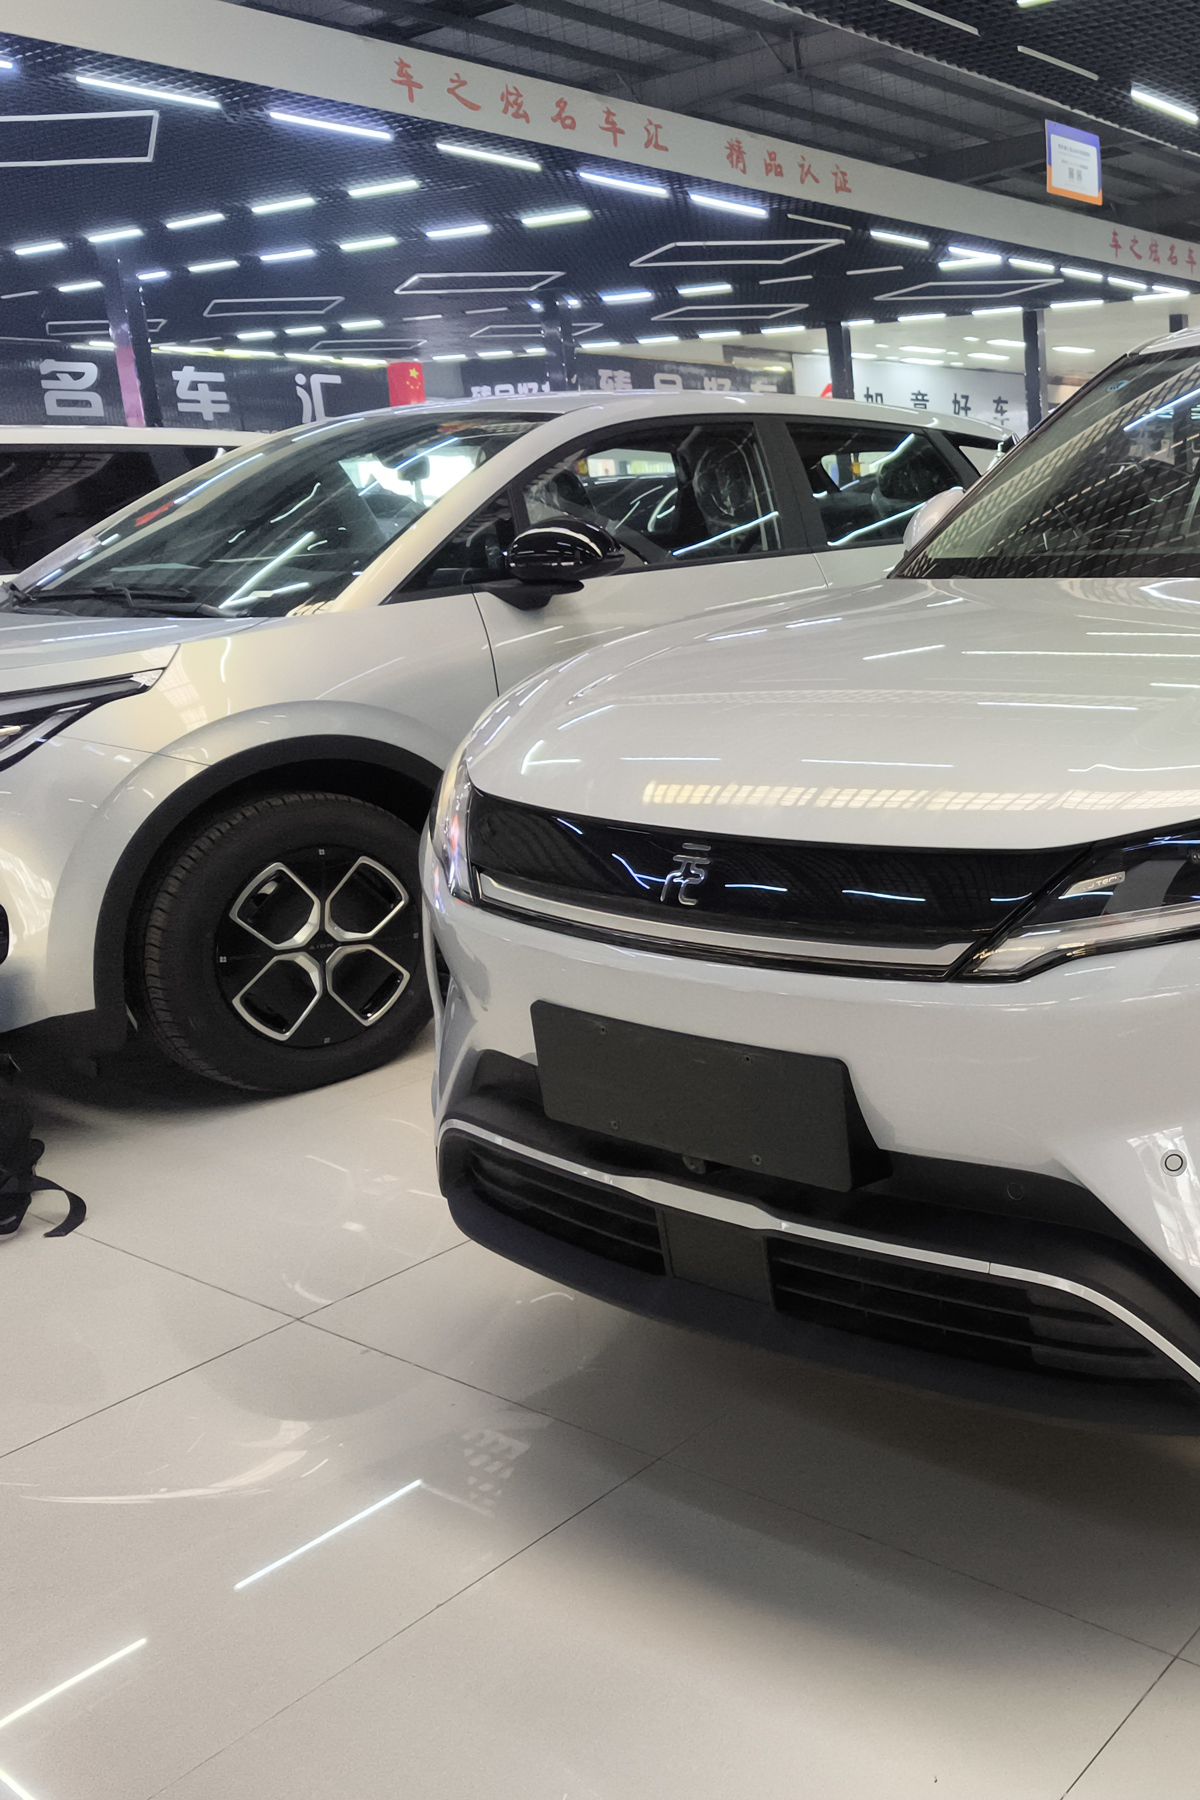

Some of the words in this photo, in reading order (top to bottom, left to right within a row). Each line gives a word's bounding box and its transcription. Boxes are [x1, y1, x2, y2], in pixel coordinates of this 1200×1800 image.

[389, 56, 669, 152] 车之炫名车汇
[725, 138, 852, 193] 精品认证
[39, 358, 342, 424] 名车汇
